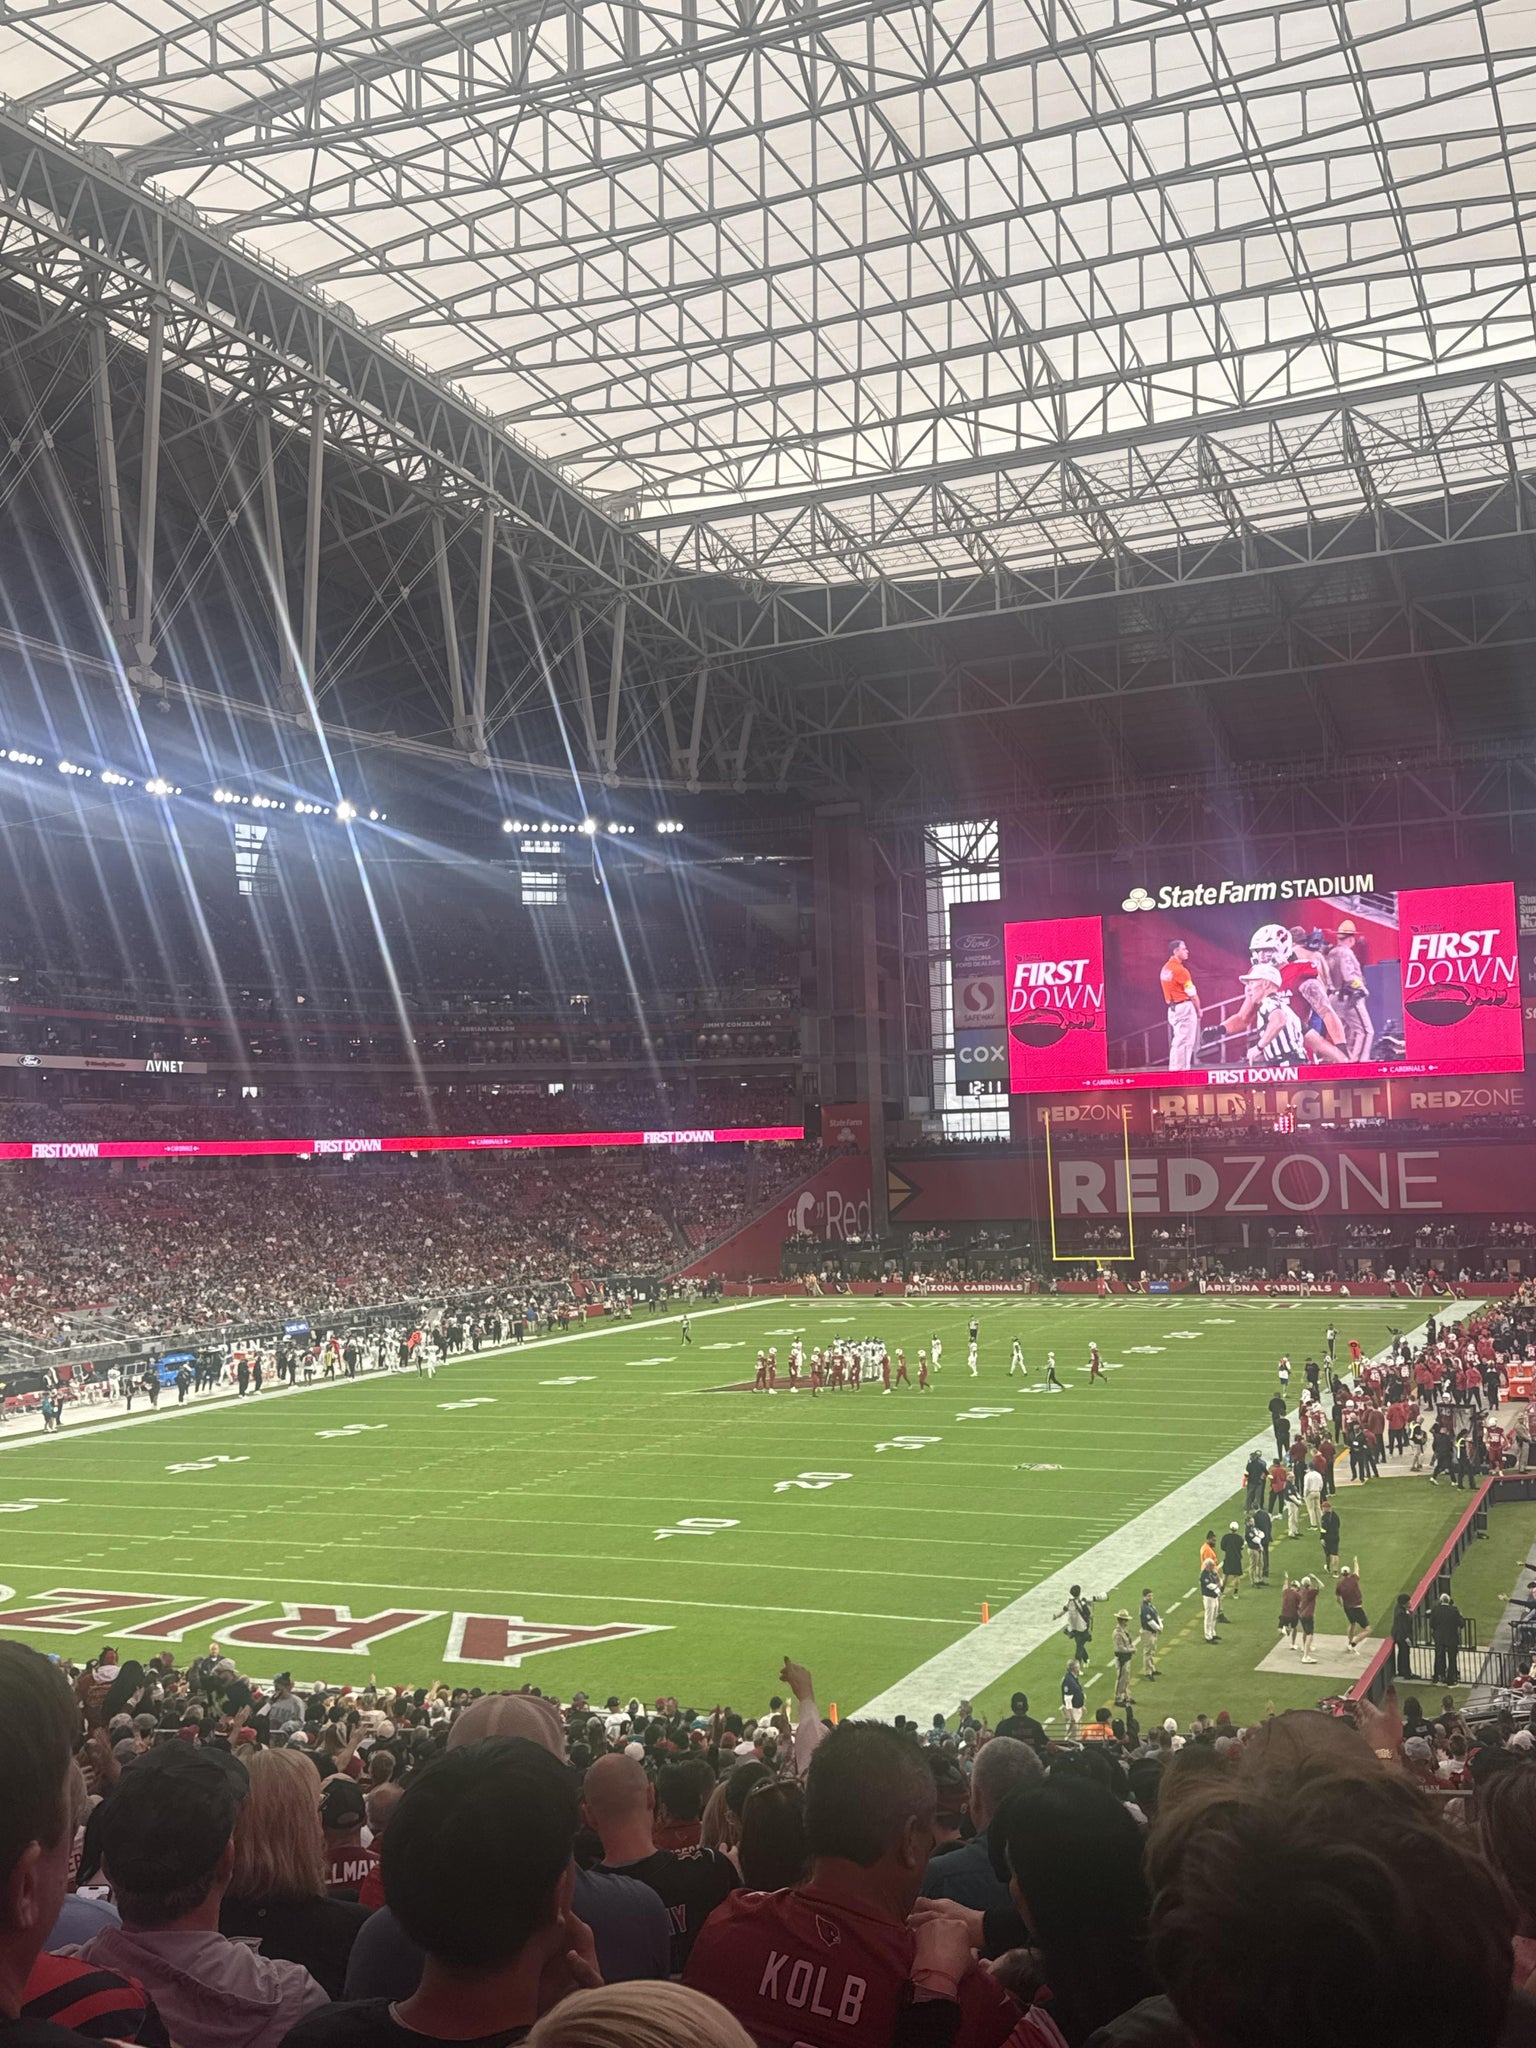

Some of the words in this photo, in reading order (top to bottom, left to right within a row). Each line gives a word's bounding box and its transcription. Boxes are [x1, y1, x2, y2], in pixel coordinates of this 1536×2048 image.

[1280, 874, 1374, 899] STADIUM
[963, 935, 991, 949] Ford
[1409, 929, 1501, 960] FIRST
[1013, 959, 1090, 987] FIRST
[1405, 955, 1518, 988] DOWN
[1010, 983, 1105, 1013] DOWN
[964, 1013, 995, 1021] SAFEWAY
[959, 1046, 1005, 1063] COX
[1208, 1070, 1246, 1084] FIRST
[1248, 1067, 1298, 1083] DOWN
[1389, 1065, 1426, 1073] CARDINALS
[969, 1081, 1002, 1094] 12:11
[1092, 1078, 1124, 1086] CARDINALS
[1253, 1087, 1381, 1121] LIGHT
[1411, 1089, 1525, 1109] REDZONE
[1037, 1104, 1133, 1122] REDZONE
[314, 1140, 344, 1153] FIRST
[344, 1139, 382, 1152] DOWN
[643, 1131, 674, 1144] FIRST
[675, 1130, 714, 1143] DOWN
[32, 1143, 61, 1158] FIRST
[62, 1143, 99, 1158] DOWN
[1058, 1151, 1443, 1214] REDZONE
[826, 1188, 872, 1240] Red
[963, 1284, 1023, 1292] CARDINALS
[1516, 1386, 1525, 1394] G
[874, 1435, 943, 1450] 30
[774, 1472, 854, 1490] 20
[652, 1517, 741, 1537] 10
[0, 1582, 676, 1668] ARIZ
[758, 1950, 868, 2026] KOLB
